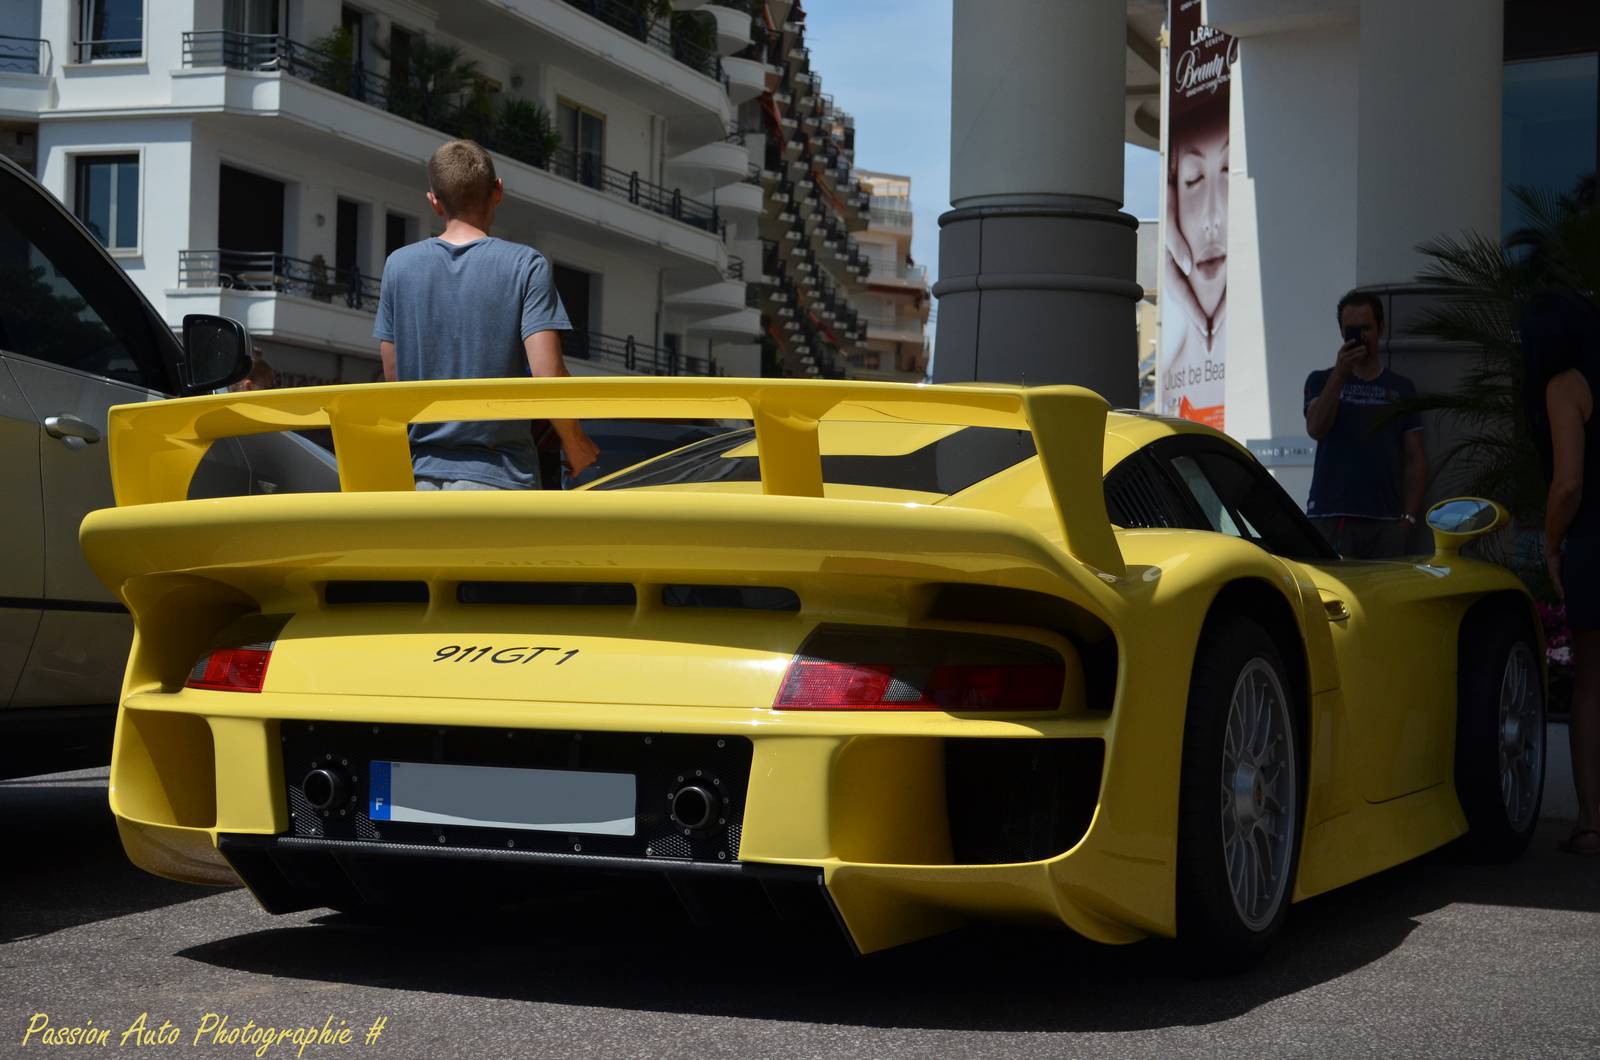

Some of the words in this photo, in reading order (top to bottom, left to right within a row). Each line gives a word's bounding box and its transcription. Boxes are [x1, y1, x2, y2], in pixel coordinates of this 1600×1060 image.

[1175, 46, 1225, 95] Beauty
[1165, 367, 1186, 391] Just
[1188, 362, 1202, 386] be
[375, 797, 385, 811] F
